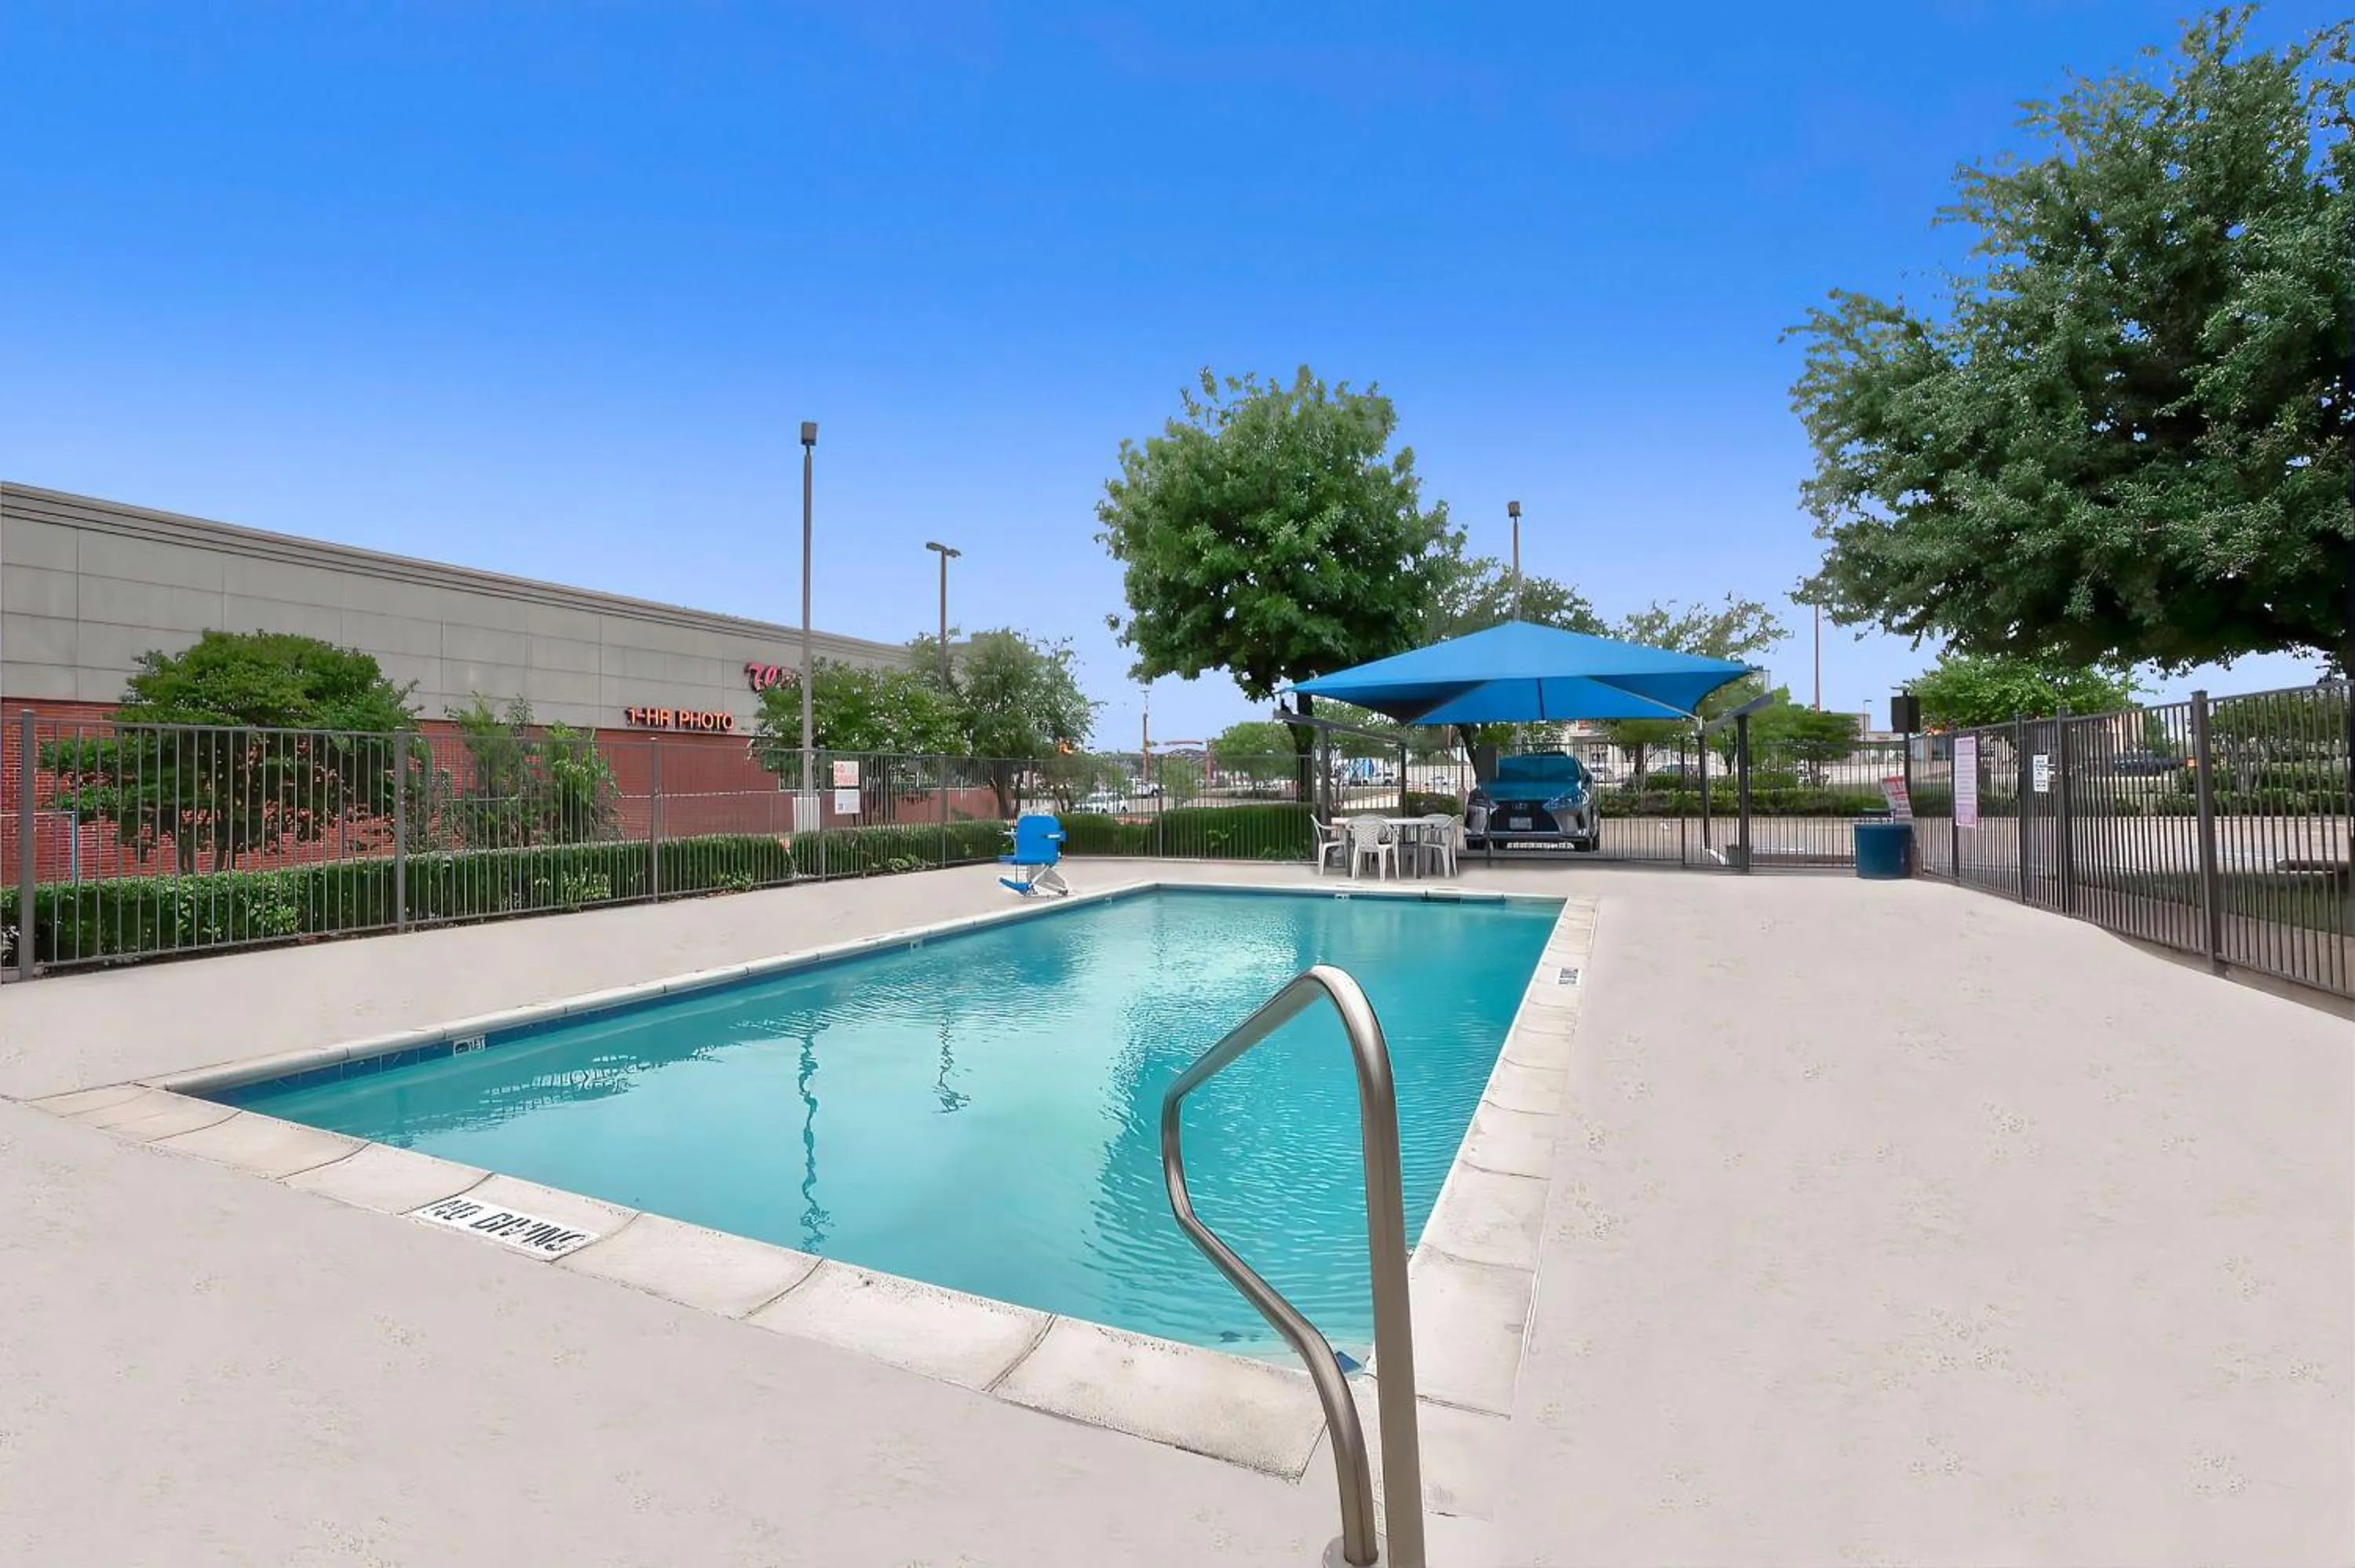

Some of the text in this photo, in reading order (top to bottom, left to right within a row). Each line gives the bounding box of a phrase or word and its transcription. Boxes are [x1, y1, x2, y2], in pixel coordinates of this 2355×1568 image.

[679, 709, 734, 729] PHOTO
[430, 1200, 586, 1252] NO DIVING
